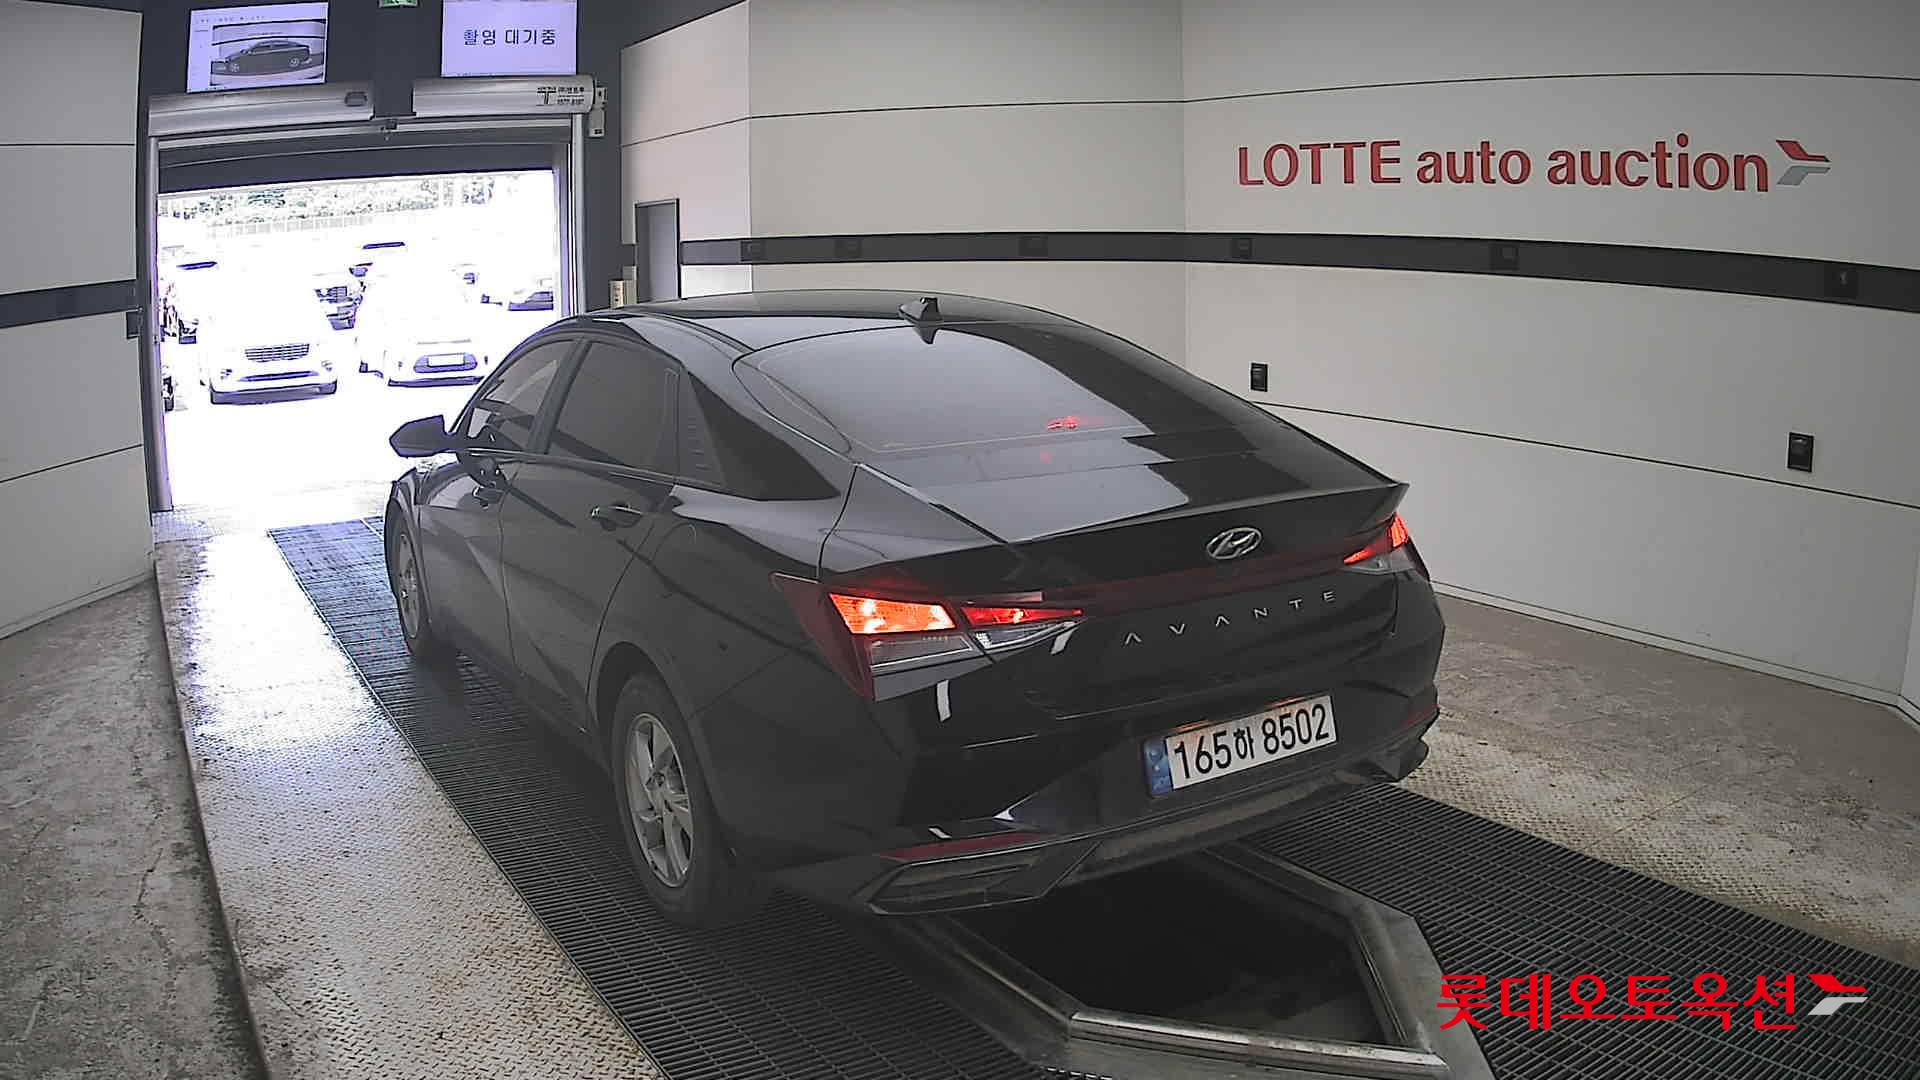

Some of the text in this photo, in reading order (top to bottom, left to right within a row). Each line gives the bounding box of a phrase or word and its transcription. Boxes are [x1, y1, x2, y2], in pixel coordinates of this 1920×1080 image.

[463, 28, 556, 46] 촬영 대기중
[1238, 134, 1769, 193] LOTTE auto auction
[1124, 590, 1335, 645] AVANTE
[1174, 703, 1330, 779] 165하 8502
